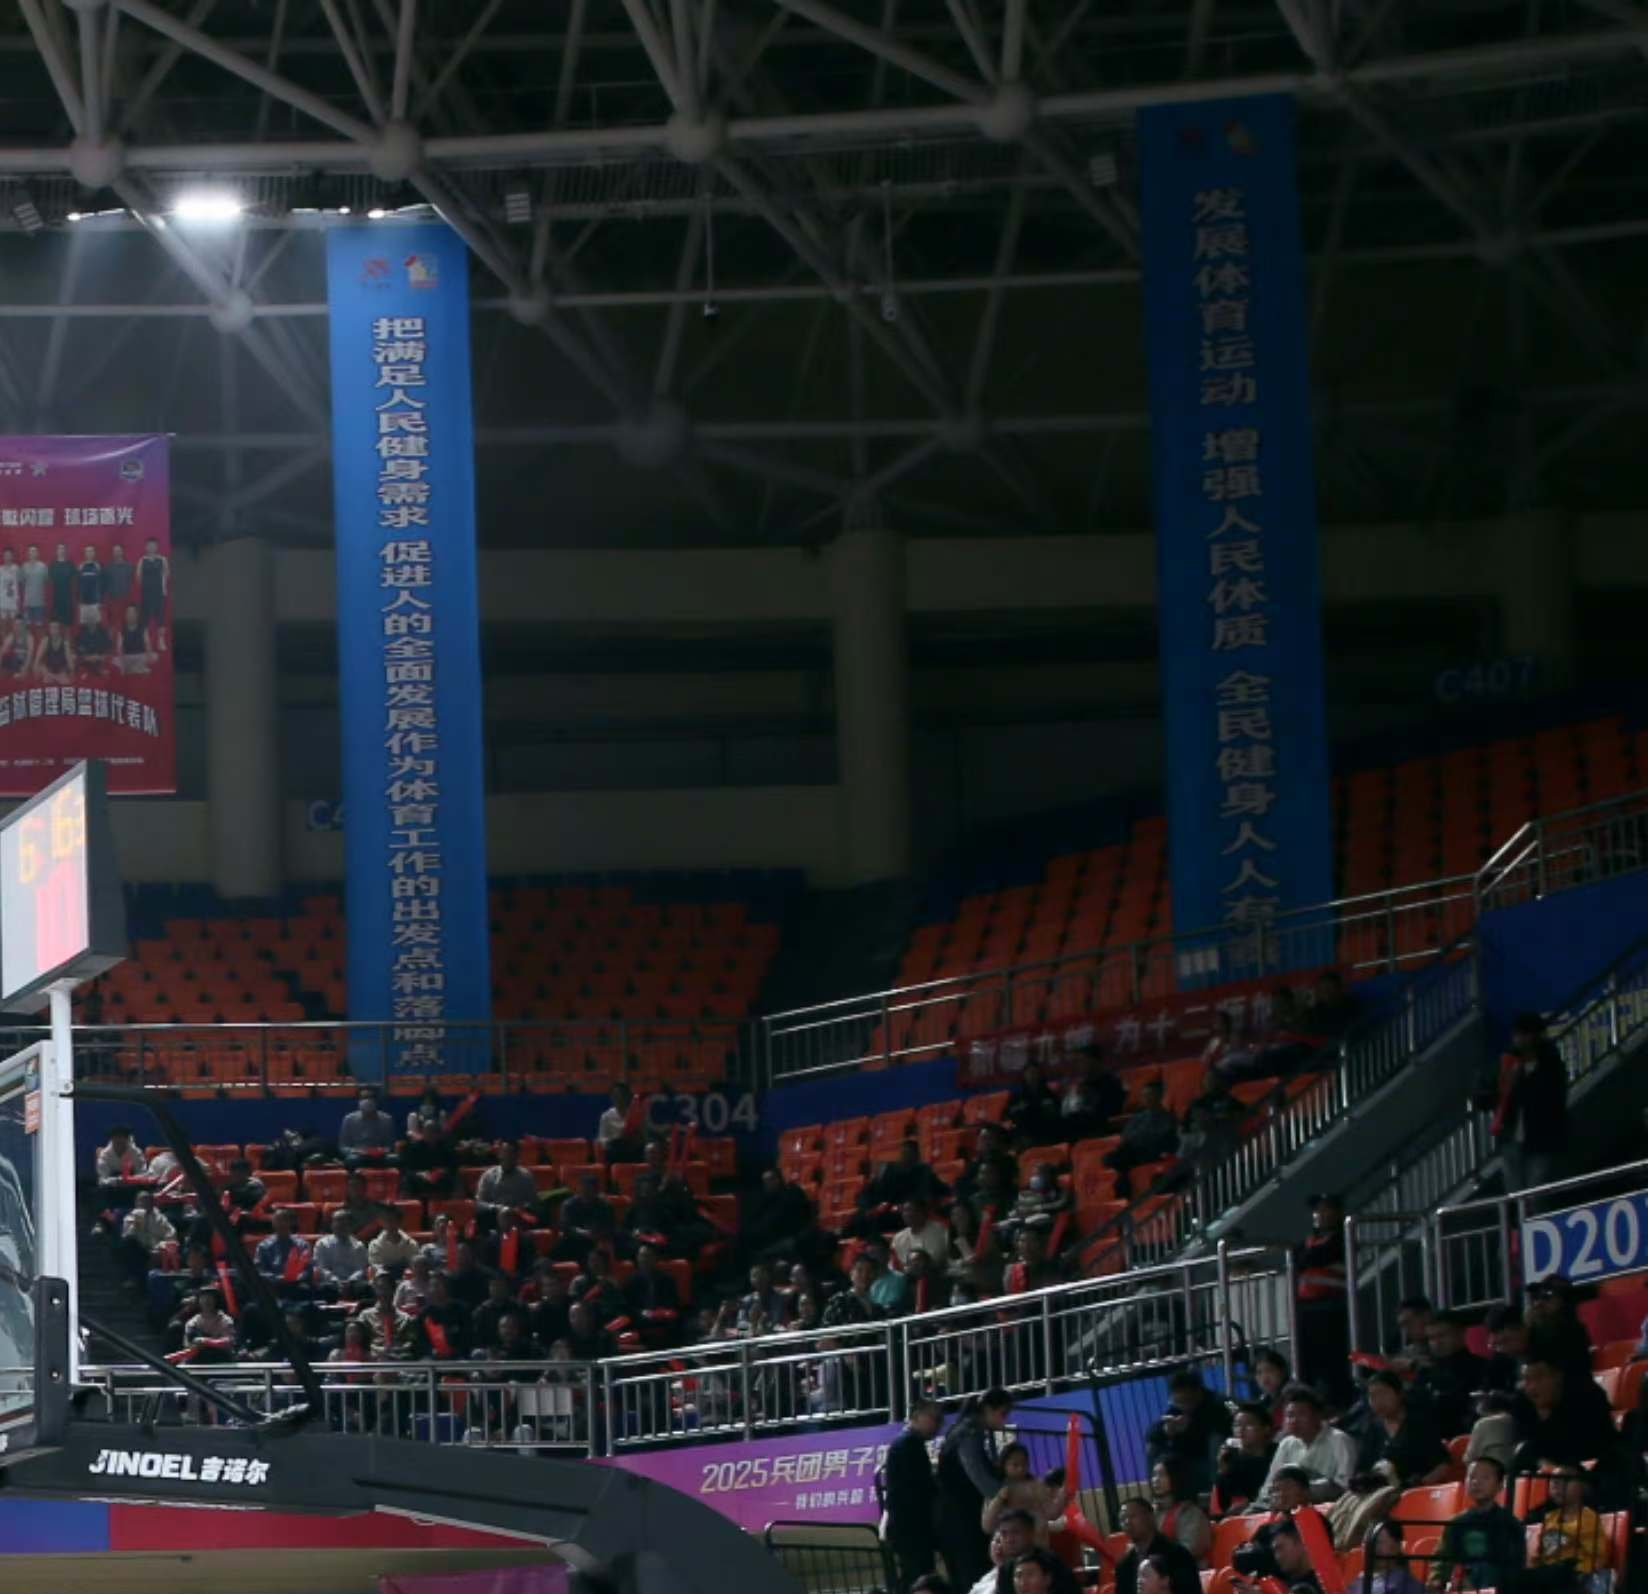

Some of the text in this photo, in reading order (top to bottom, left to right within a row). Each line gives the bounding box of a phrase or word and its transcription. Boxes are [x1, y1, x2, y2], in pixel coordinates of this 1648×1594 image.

[1190, 187, 1258, 407] 发展体育运动
[371, 315, 430, 529] 把满足人民健身需求
[1201, 428, 1268, 652] 增强人民体质
[1521, 1199, 1648, 1289] D20
[88, 1448, 271, 1486] JINOEL 吉诺尔
